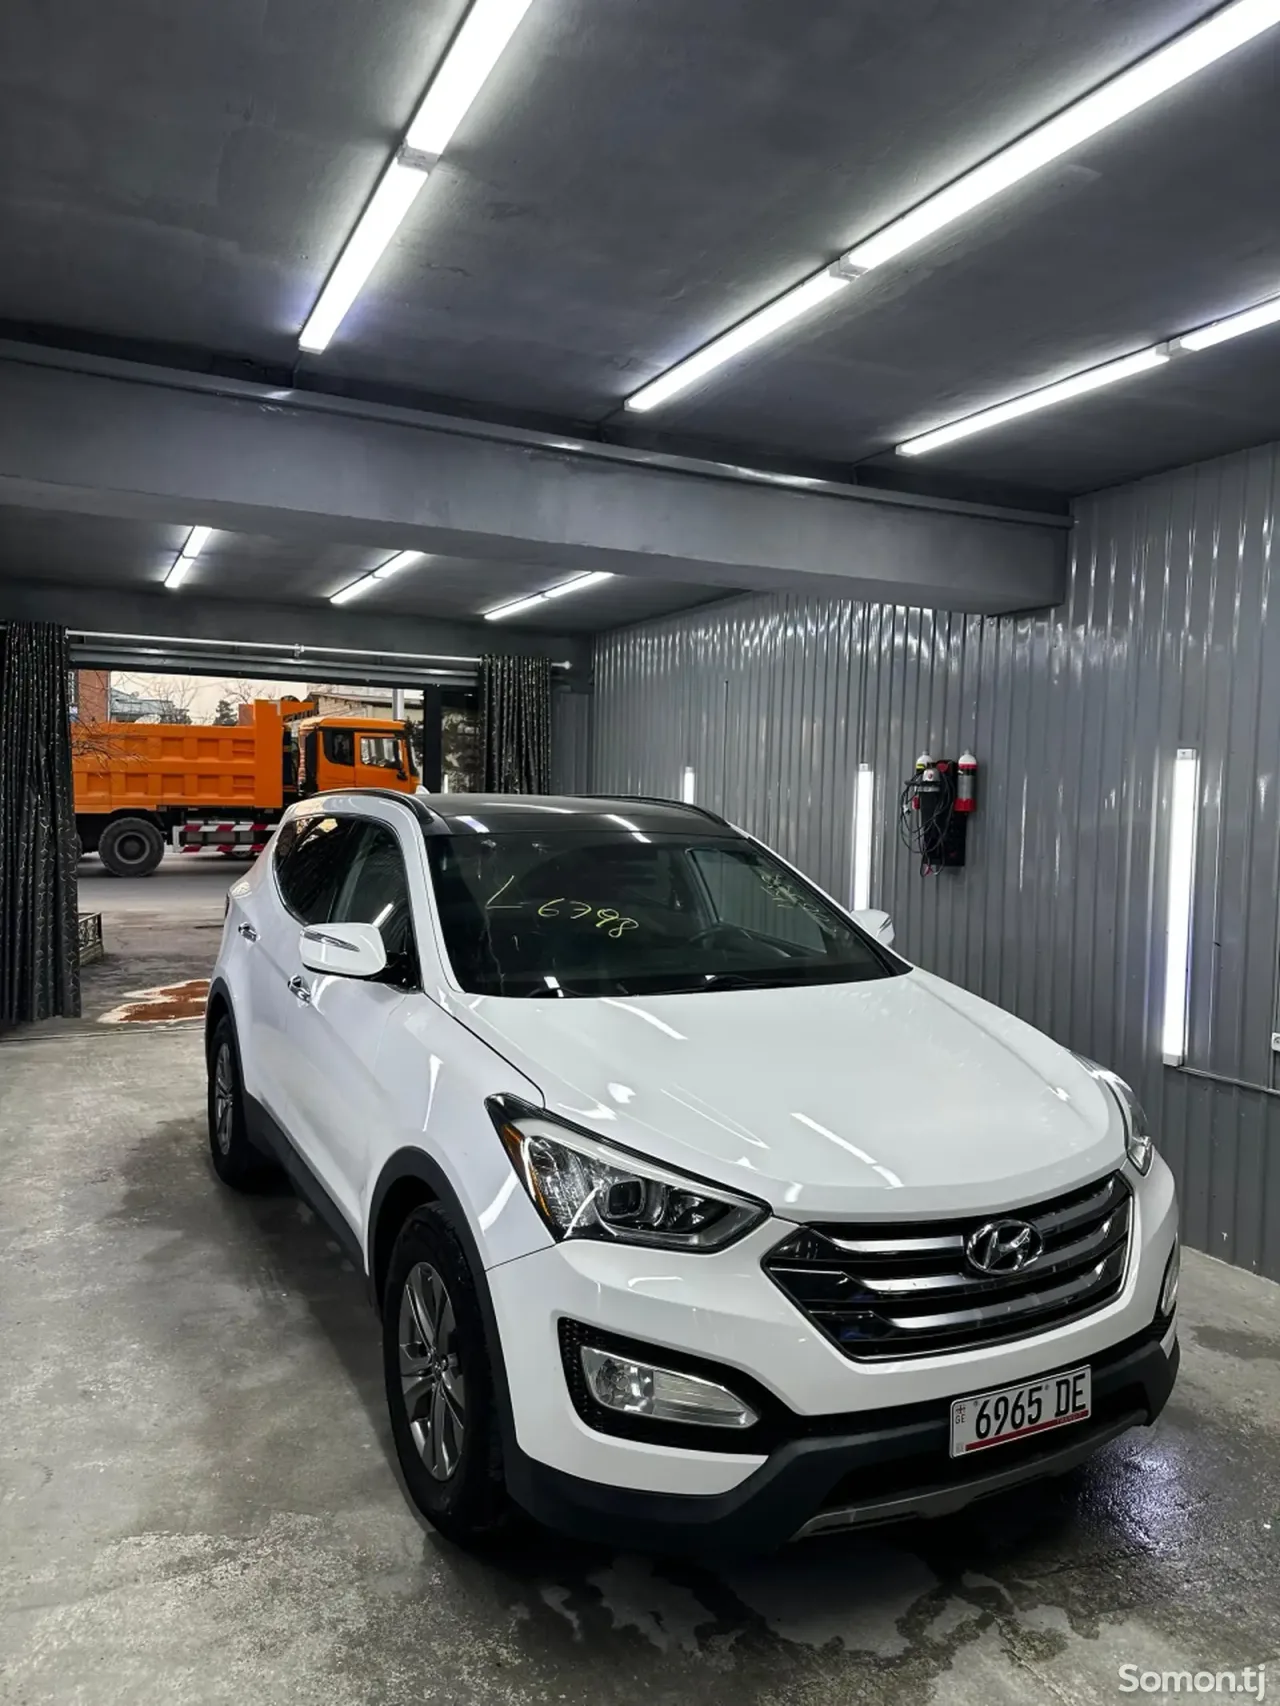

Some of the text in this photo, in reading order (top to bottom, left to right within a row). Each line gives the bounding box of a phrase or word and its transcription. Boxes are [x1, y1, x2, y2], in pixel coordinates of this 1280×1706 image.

[955, 1414, 966, 1425] GE
[975, 1373, 1087, 1440] 6965 DE
